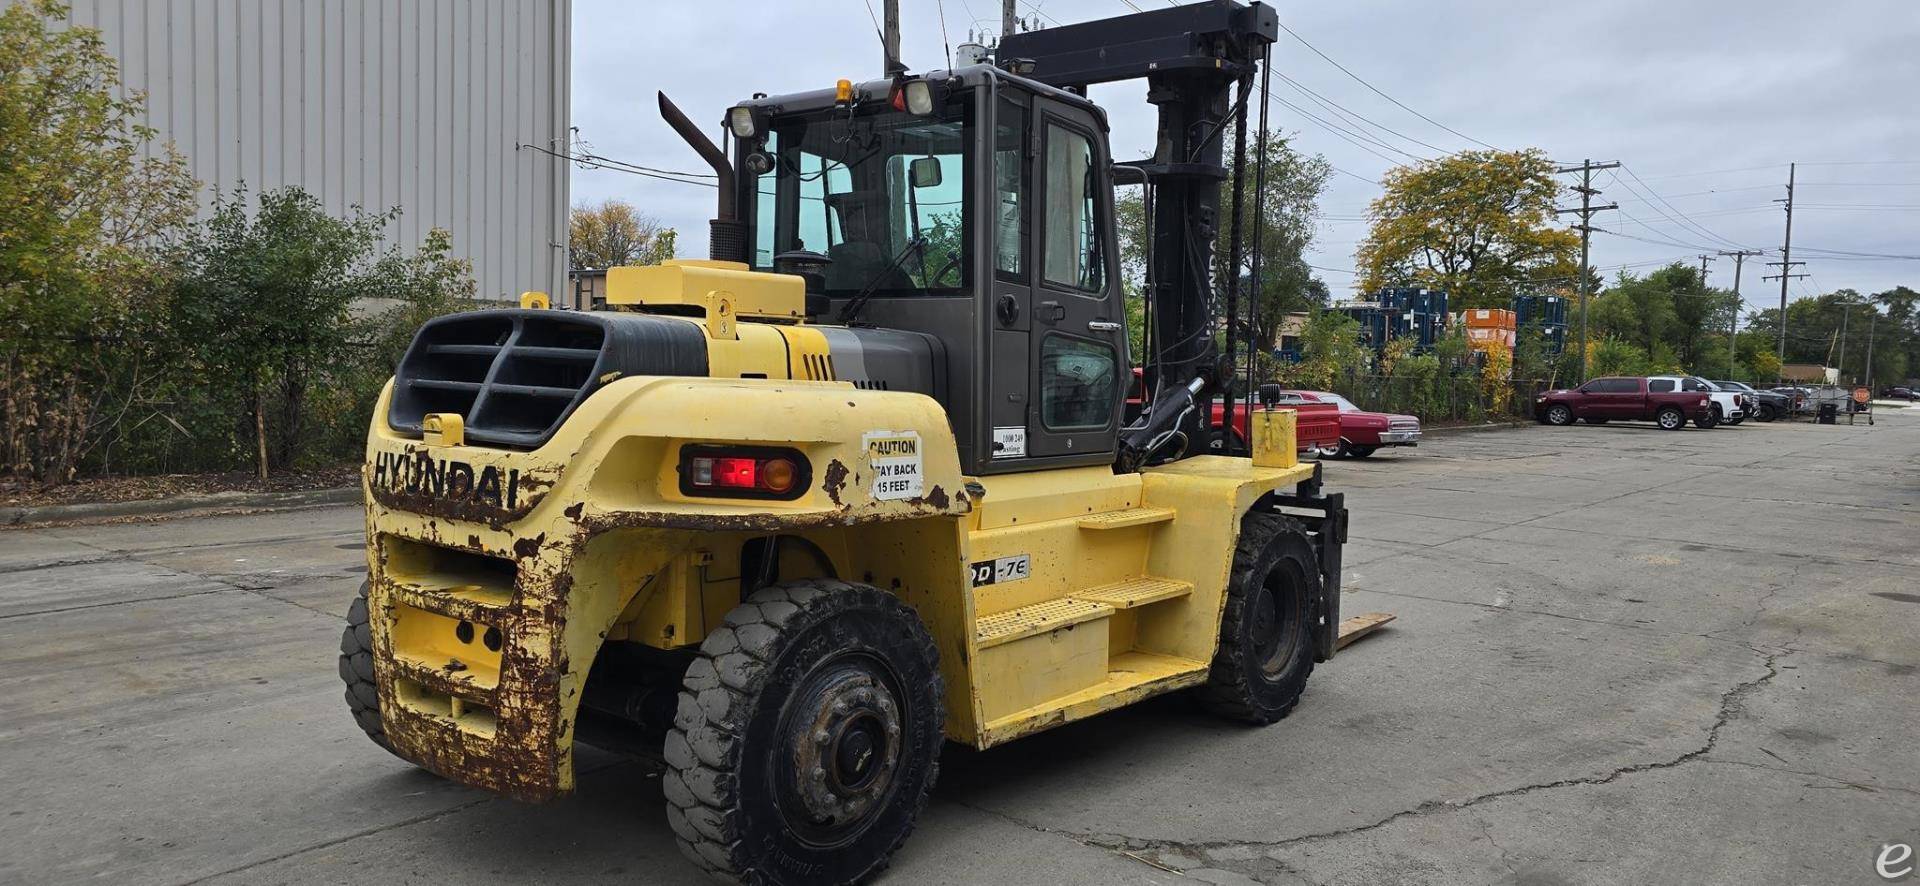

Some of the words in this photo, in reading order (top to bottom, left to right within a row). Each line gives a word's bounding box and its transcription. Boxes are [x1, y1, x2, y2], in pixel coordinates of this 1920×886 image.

[870, 439, 916, 455] CAUTION
[875, 465, 892, 477] AY
[894, 463, 917, 475] BACK
[374, 451, 519, 510] HYUNDAI
[878, 481, 888, 493] 15
[889, 480, 910, 492] FEET
